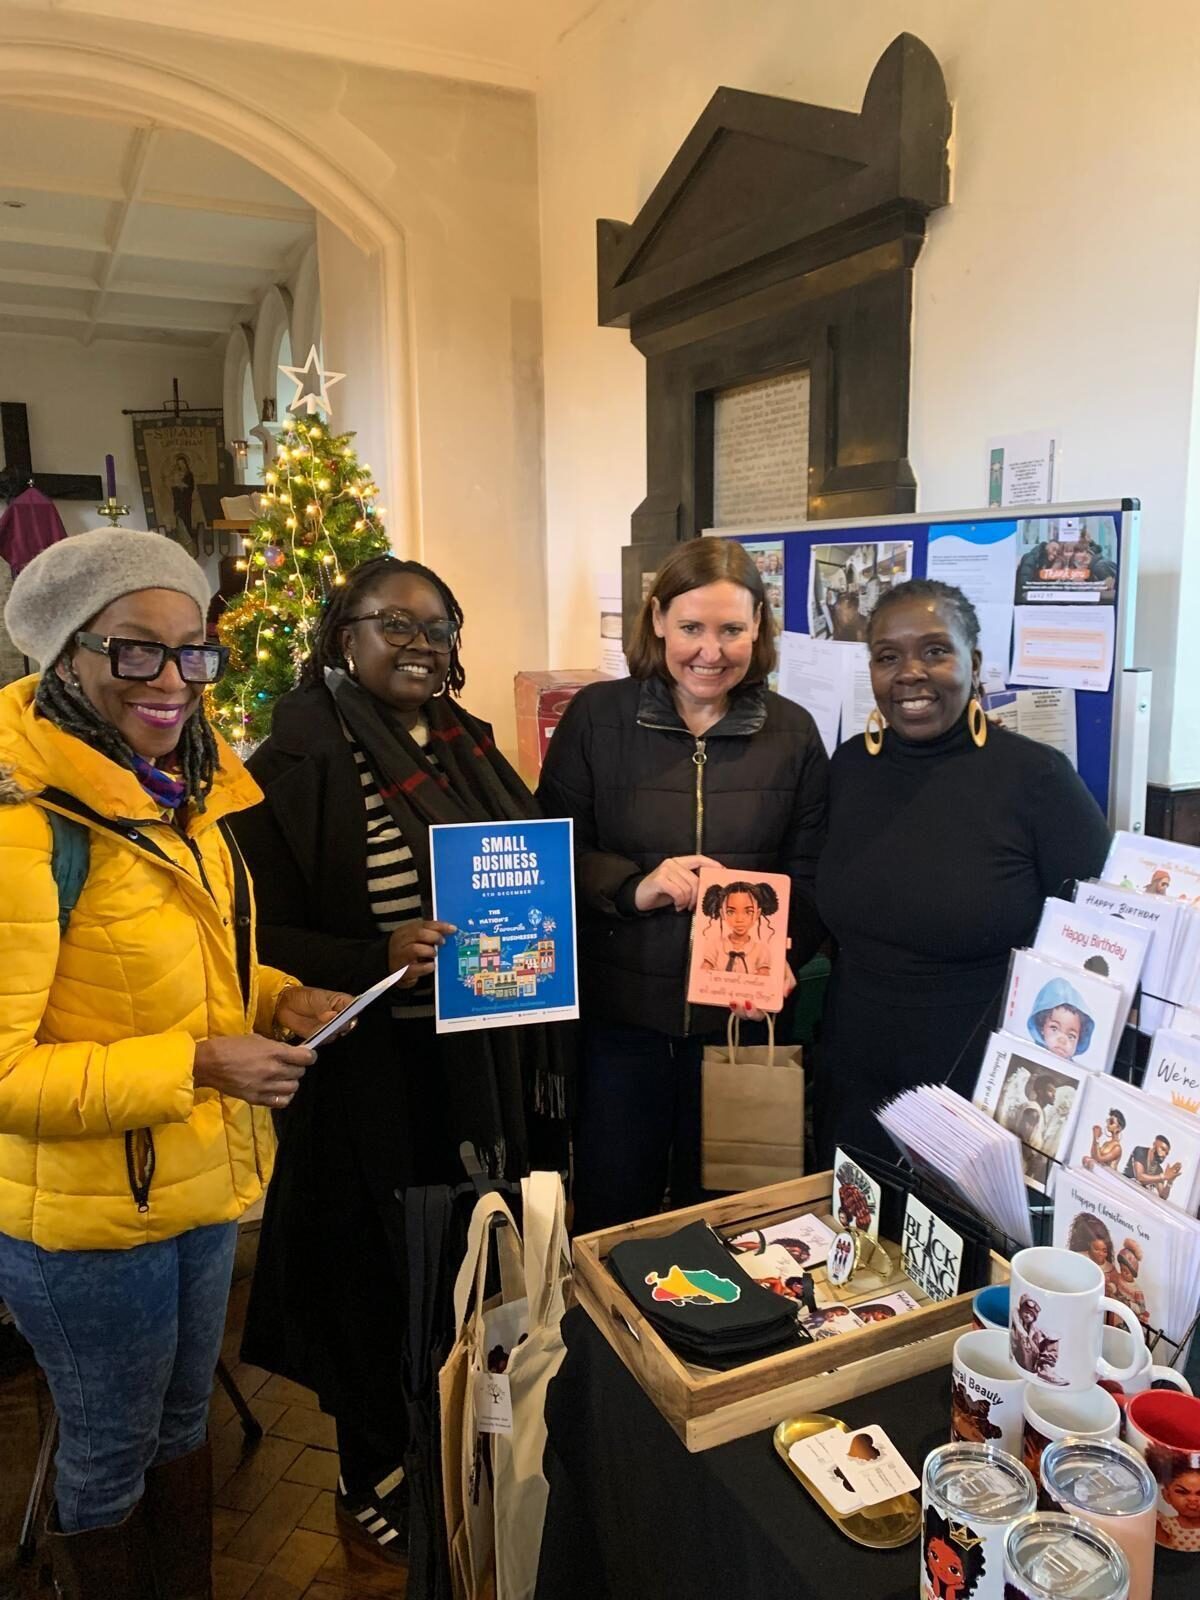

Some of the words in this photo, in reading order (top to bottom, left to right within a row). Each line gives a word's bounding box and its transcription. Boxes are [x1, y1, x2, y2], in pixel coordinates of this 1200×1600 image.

[481, 835, 528, 854] SMALL
[472, 852, 538, 872] BUSINESS
[471, 869, 540, 890] SATURDAY
[497, 889, 532, 897] DECEMBER
[1086, 894, 1115, 911] HAPPY
[488, 908, 501, 916] THE
[1061, 923, 1090, 948] Happy
[1089, 933, 1128, 961] Birthday
[1157, 1057, 1200, 1089] We're
[1071, 1187, 1096, 1213] Happy
[1098, 1202, 1134, 1233] Christmas
[903, 1233, 956, 1299] KING
[968, 1376, 1004, 1406] Beauty
